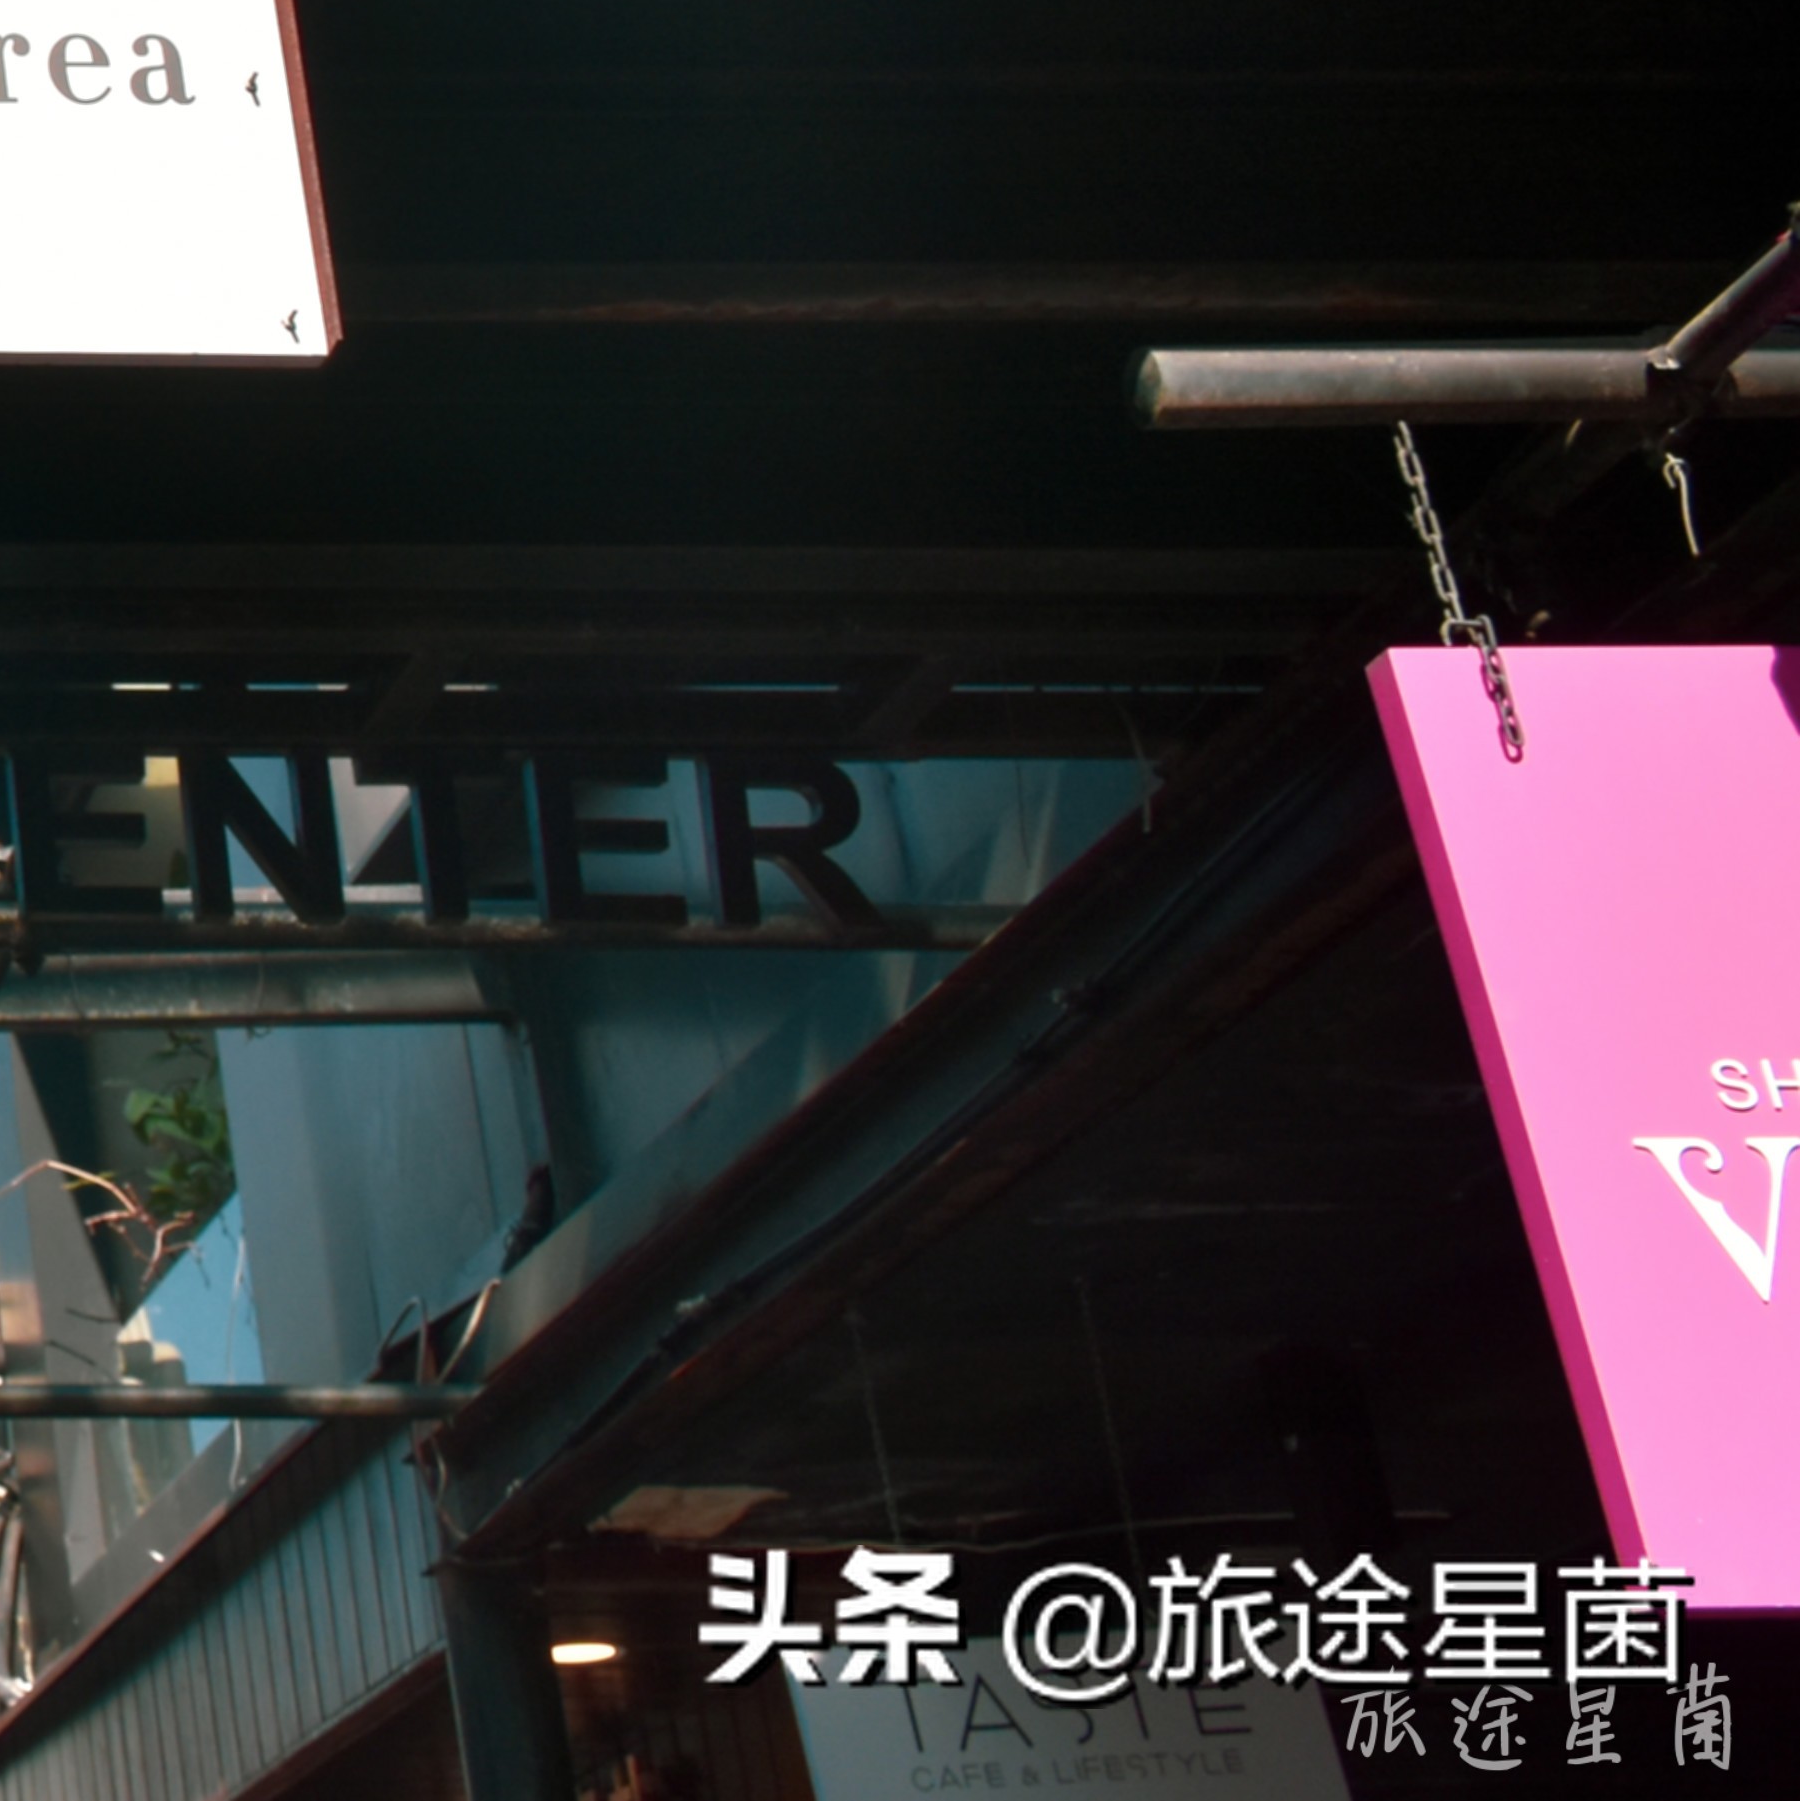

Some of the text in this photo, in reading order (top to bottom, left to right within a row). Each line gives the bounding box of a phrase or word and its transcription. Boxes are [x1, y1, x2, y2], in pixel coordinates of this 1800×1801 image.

[910, 1746, 1246, 1794] CAFE & LIFESTYLE
